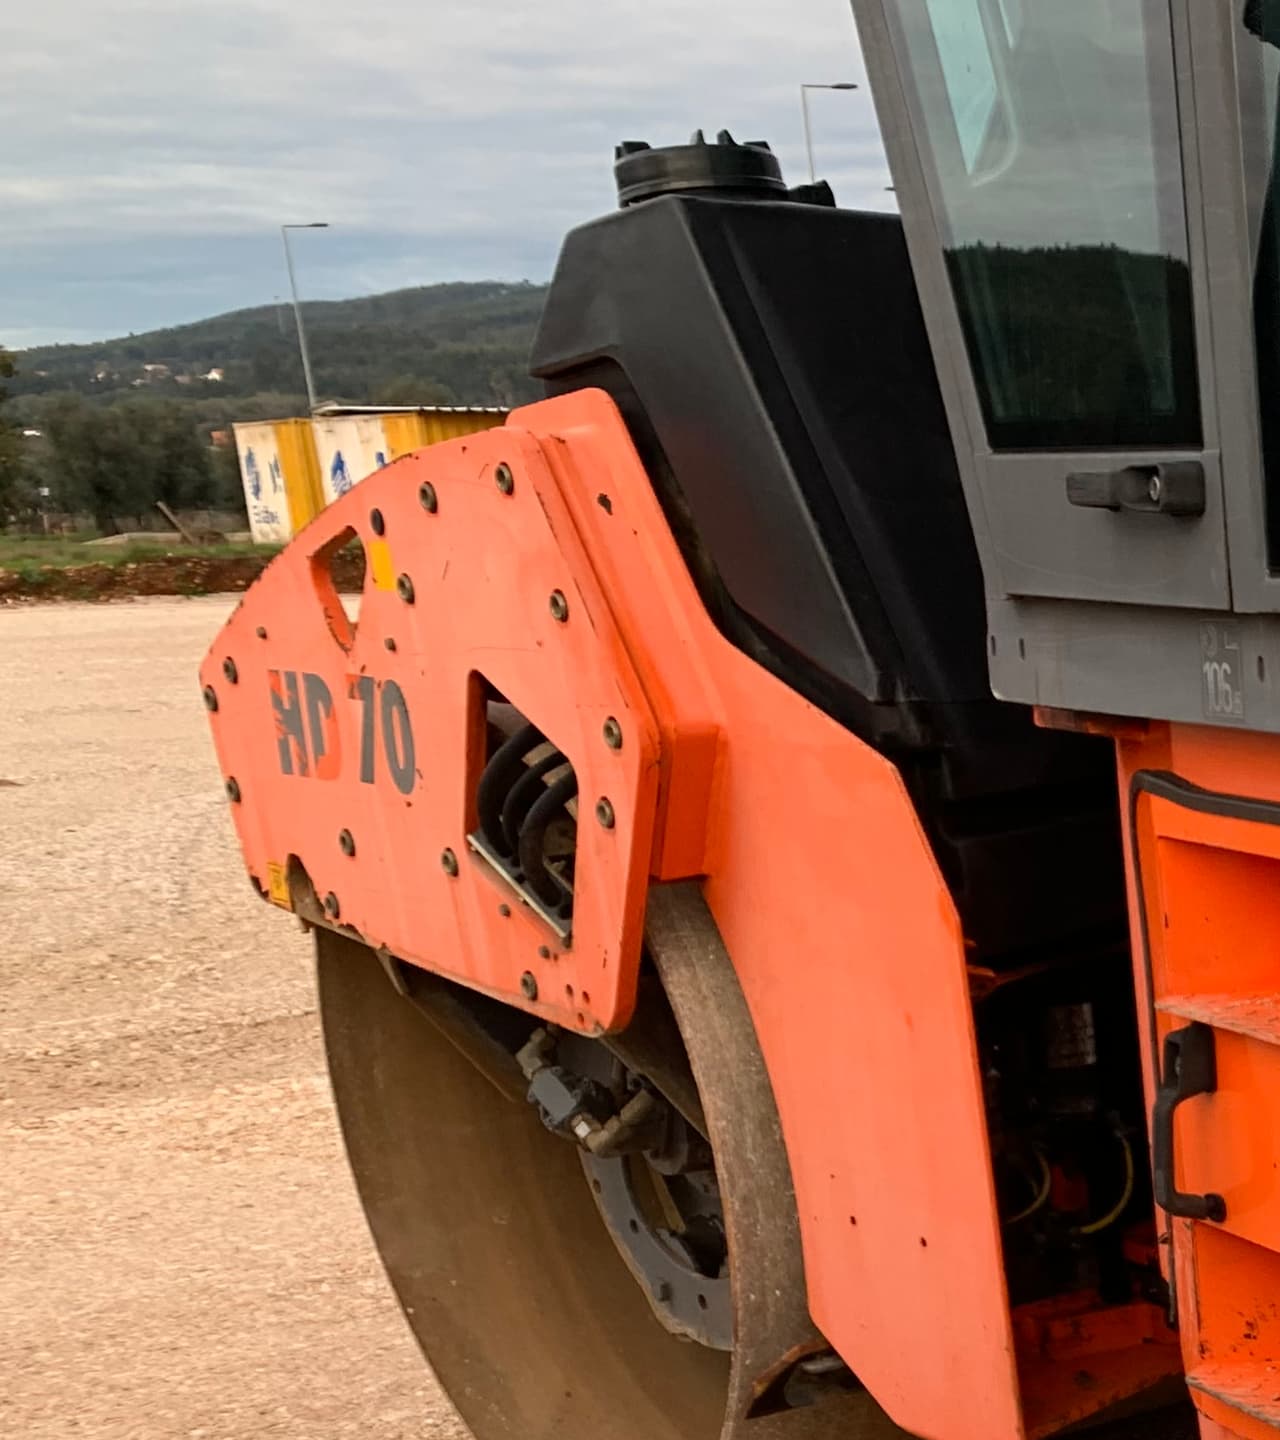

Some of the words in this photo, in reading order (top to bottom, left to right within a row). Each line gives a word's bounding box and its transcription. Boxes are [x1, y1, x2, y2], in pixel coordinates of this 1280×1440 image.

[1202, 661, 1233, 713] 106
[267, 669, 342, 781] HD
[345, 673, 416, 795] 70
